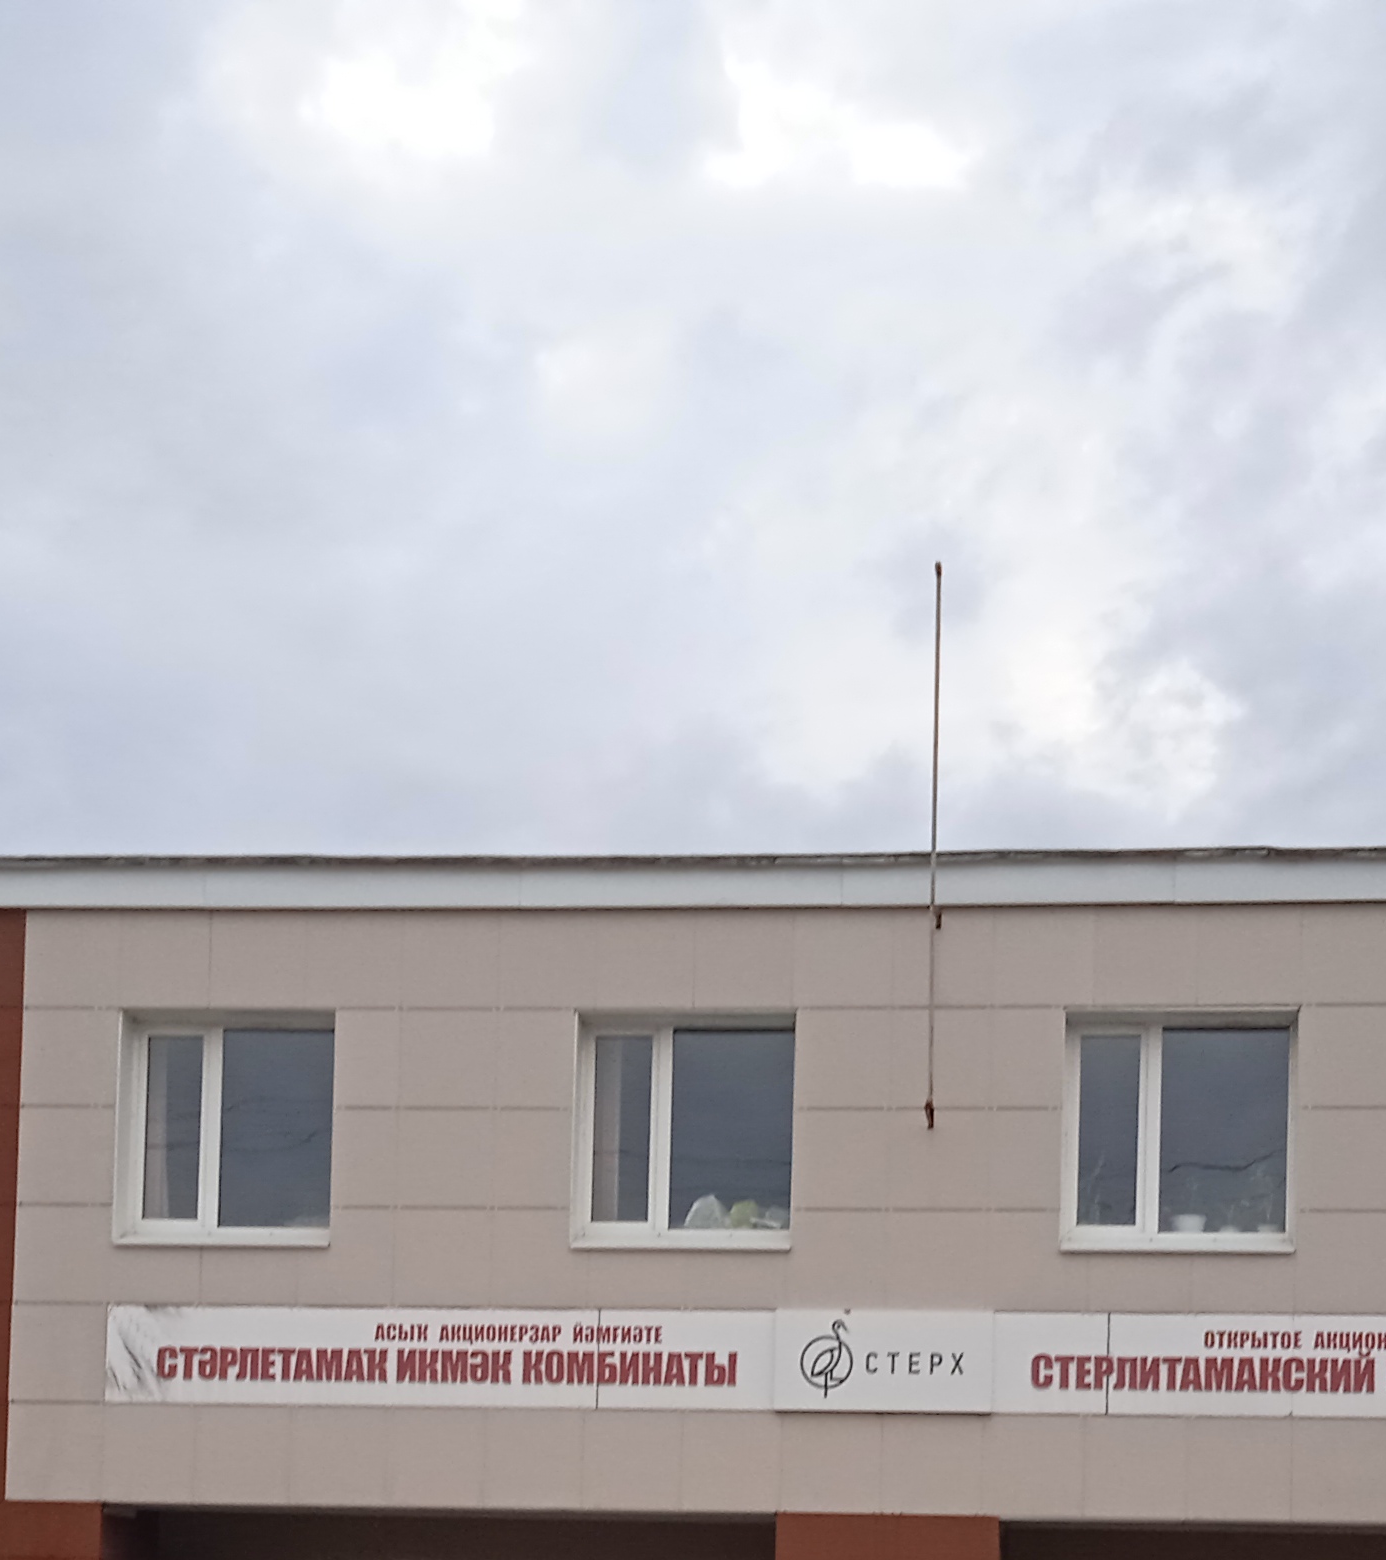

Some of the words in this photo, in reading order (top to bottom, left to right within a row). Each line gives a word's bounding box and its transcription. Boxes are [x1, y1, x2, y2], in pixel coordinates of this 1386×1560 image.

[1204, 1330, 1303, 1350] ОТКРЫТОЕ
[396, 1347, 513, 1385] ИКМӘК
[521, 1349, 739, 1388] КОМБИНАТЫ
[865, 1351, 964, 1375] СТЕРХ
[1030, 1352, 1377, 1395] СТЕРЛИТАМАКСКИЙ
